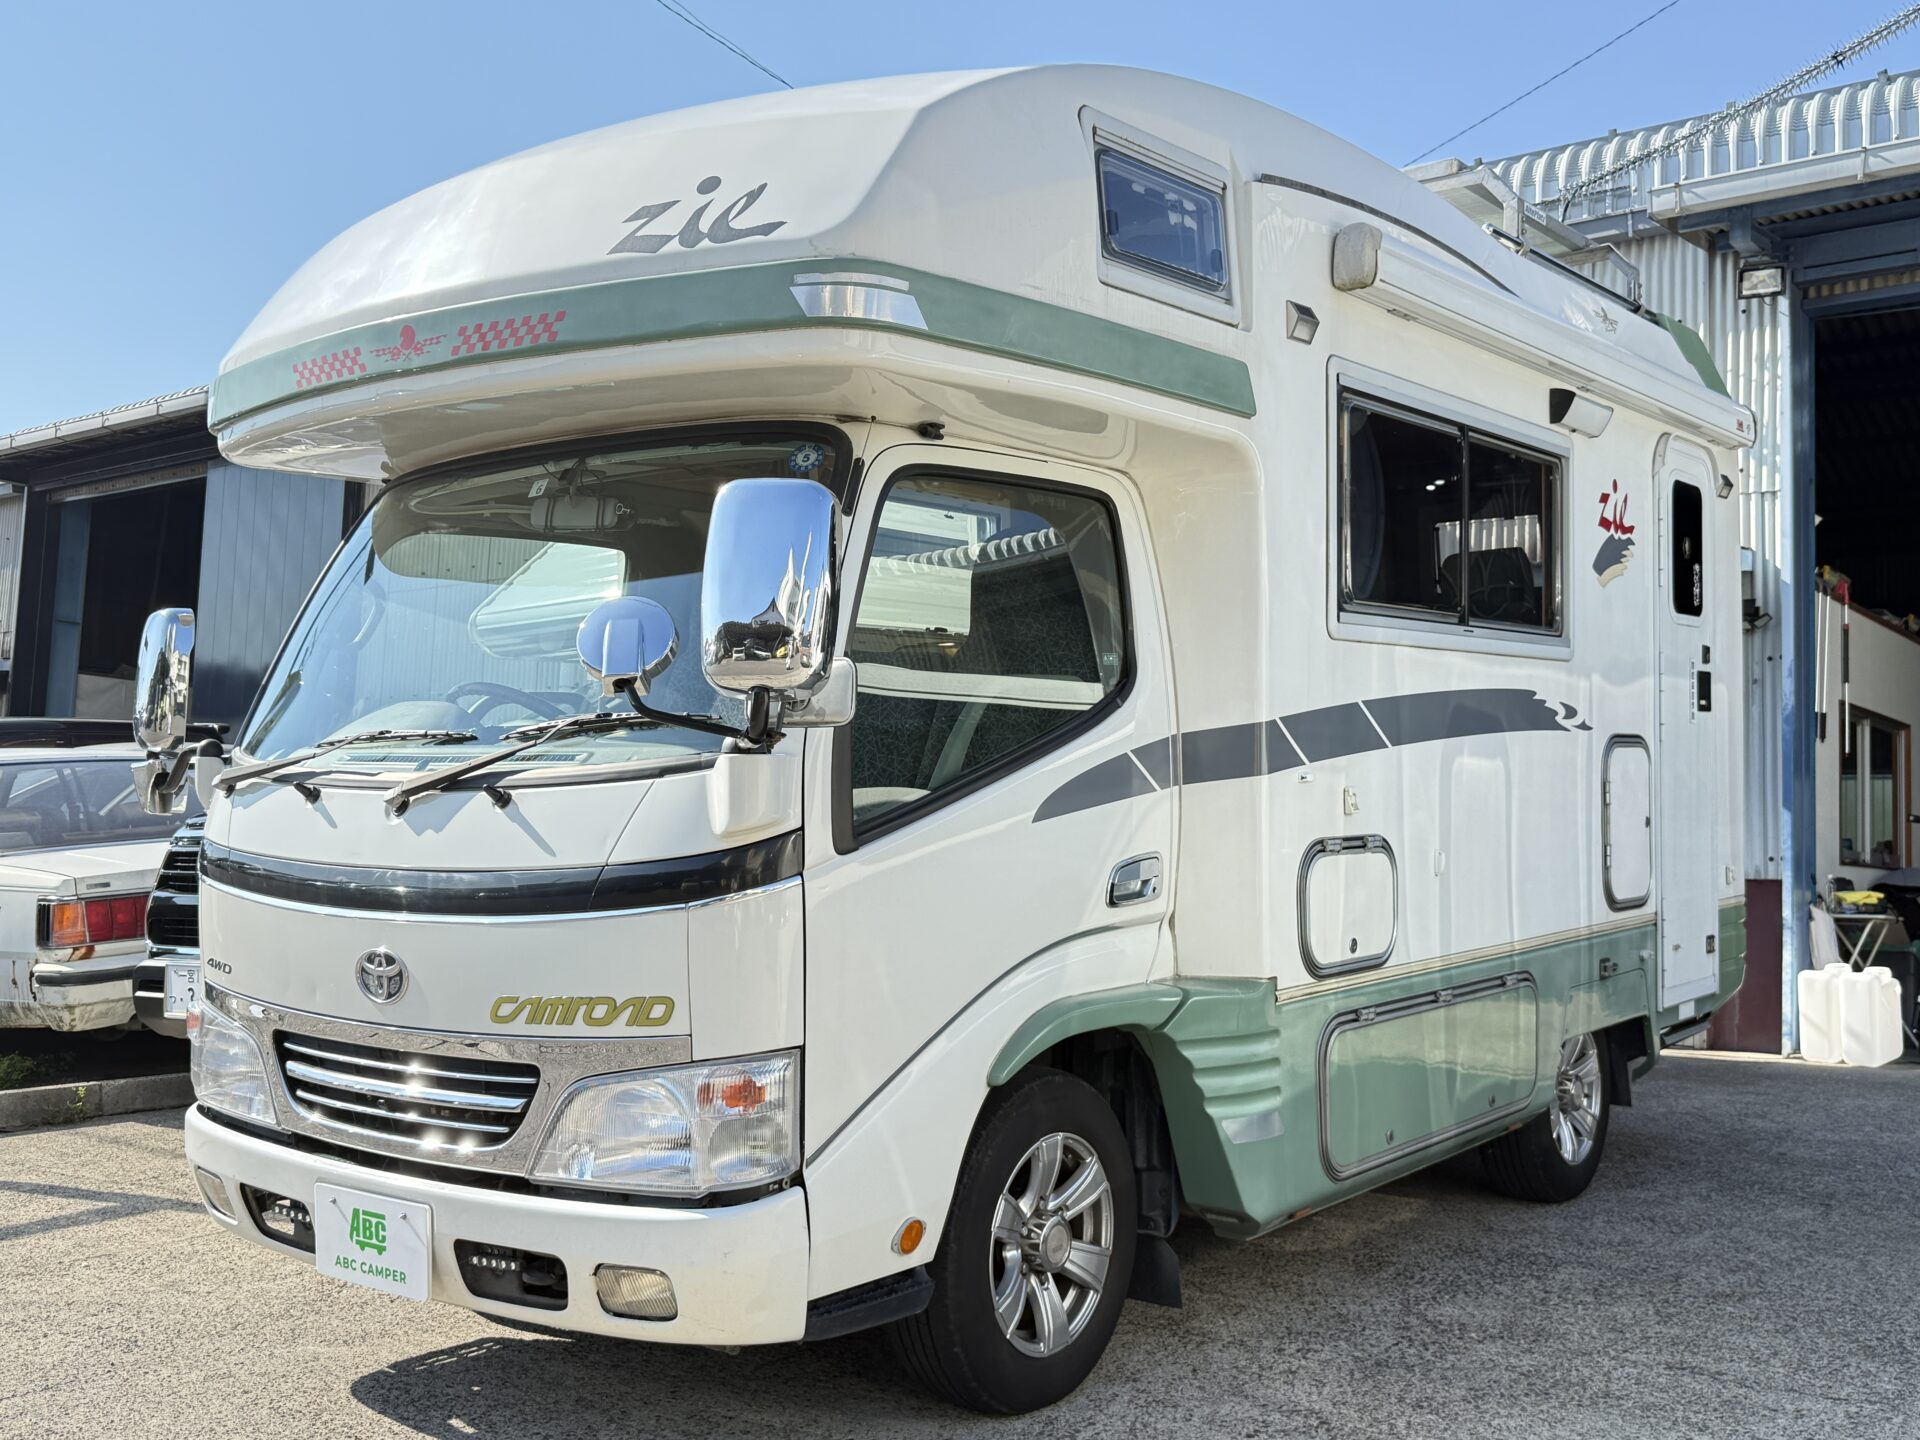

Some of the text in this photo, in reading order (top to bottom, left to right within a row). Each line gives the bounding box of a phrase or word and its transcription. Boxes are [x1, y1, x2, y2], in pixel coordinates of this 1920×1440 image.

[206, 957, 233, 975] 4WD
[490, 995, 675, 1027] CAMROAD
[350, 1207, 387, 1244] ABC
[335, 1255, 407, 1284] ABC CAMPER
